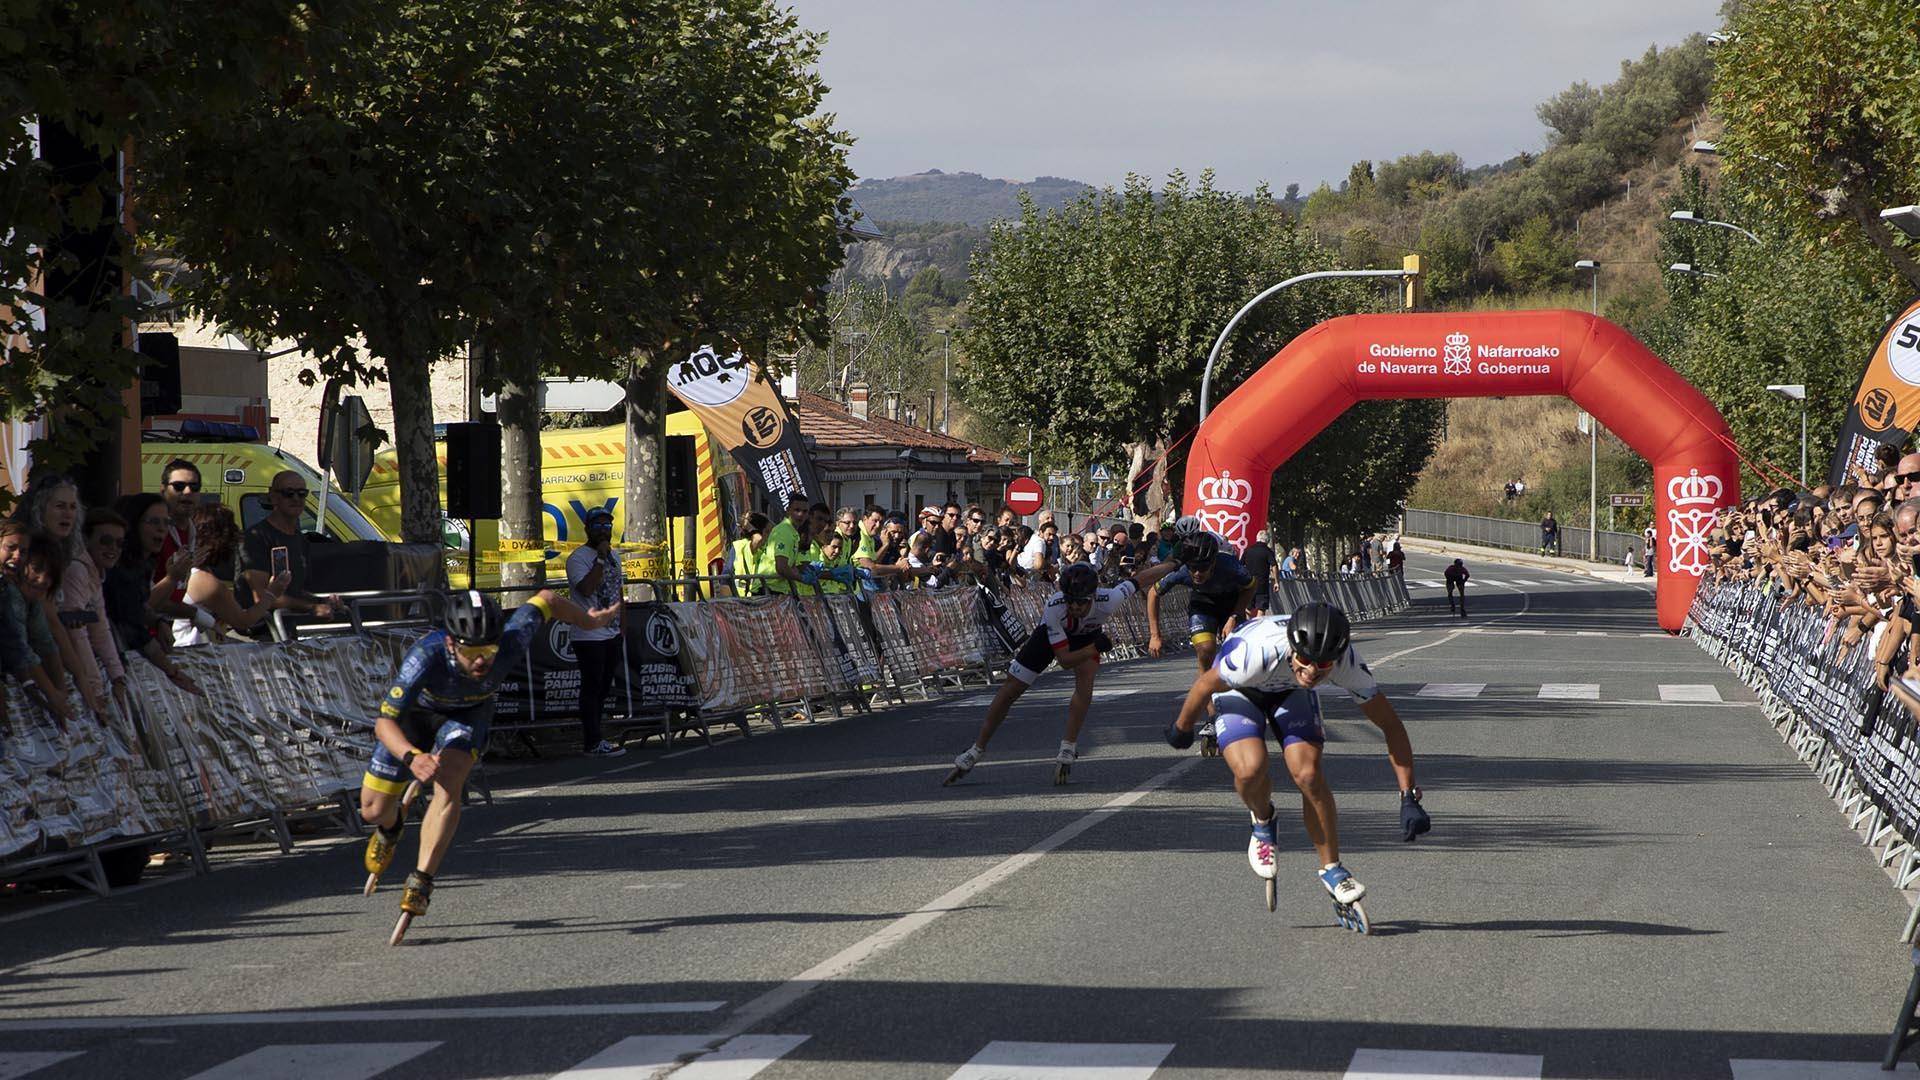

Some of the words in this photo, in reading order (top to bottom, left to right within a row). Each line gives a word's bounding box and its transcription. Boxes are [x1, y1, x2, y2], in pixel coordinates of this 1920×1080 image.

[1896, 324, 1920, 352] 5
[1369, 344, 1437, 358] Gobierno
[1478, 345, 1560, 358] Nafarroako
[1358, 361, 1376, 374] de
[1380, 362, 1437, 374] Navarra
[1478, 362, 1550, 374] Gobernua
[589, 471, 624, 482] BIZI-EU
[640, 663, 677, 675] ZUBIRI
[544, 680, 582, 690] PAMP
[545, 689, 581, 700] PUEN
